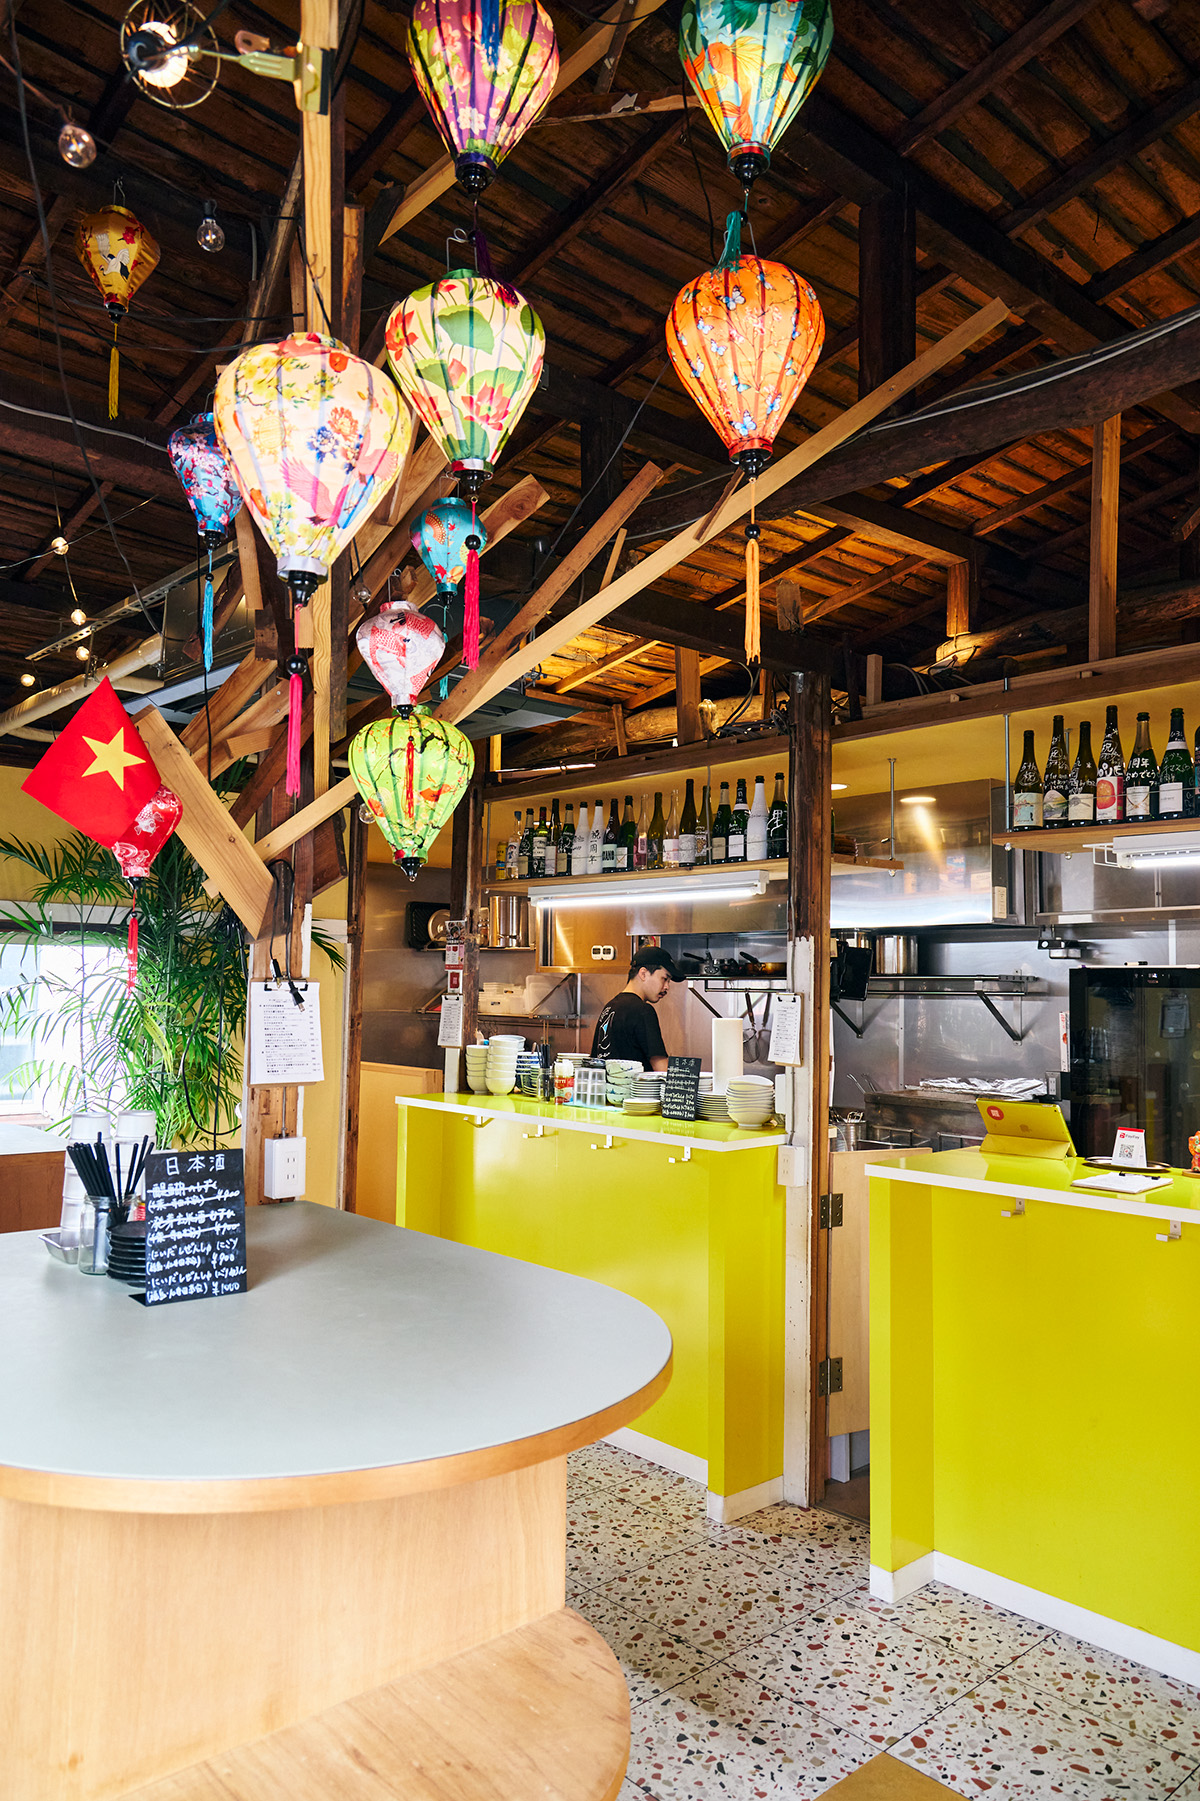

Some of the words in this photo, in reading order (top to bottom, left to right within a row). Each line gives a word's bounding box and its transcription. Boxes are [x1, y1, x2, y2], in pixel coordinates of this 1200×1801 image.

[166, 1154, 225, 1175] 日本酒
[211, 1252, 235, 1269] ¥900
[212, 1281, 240, 1296] ¥1000
